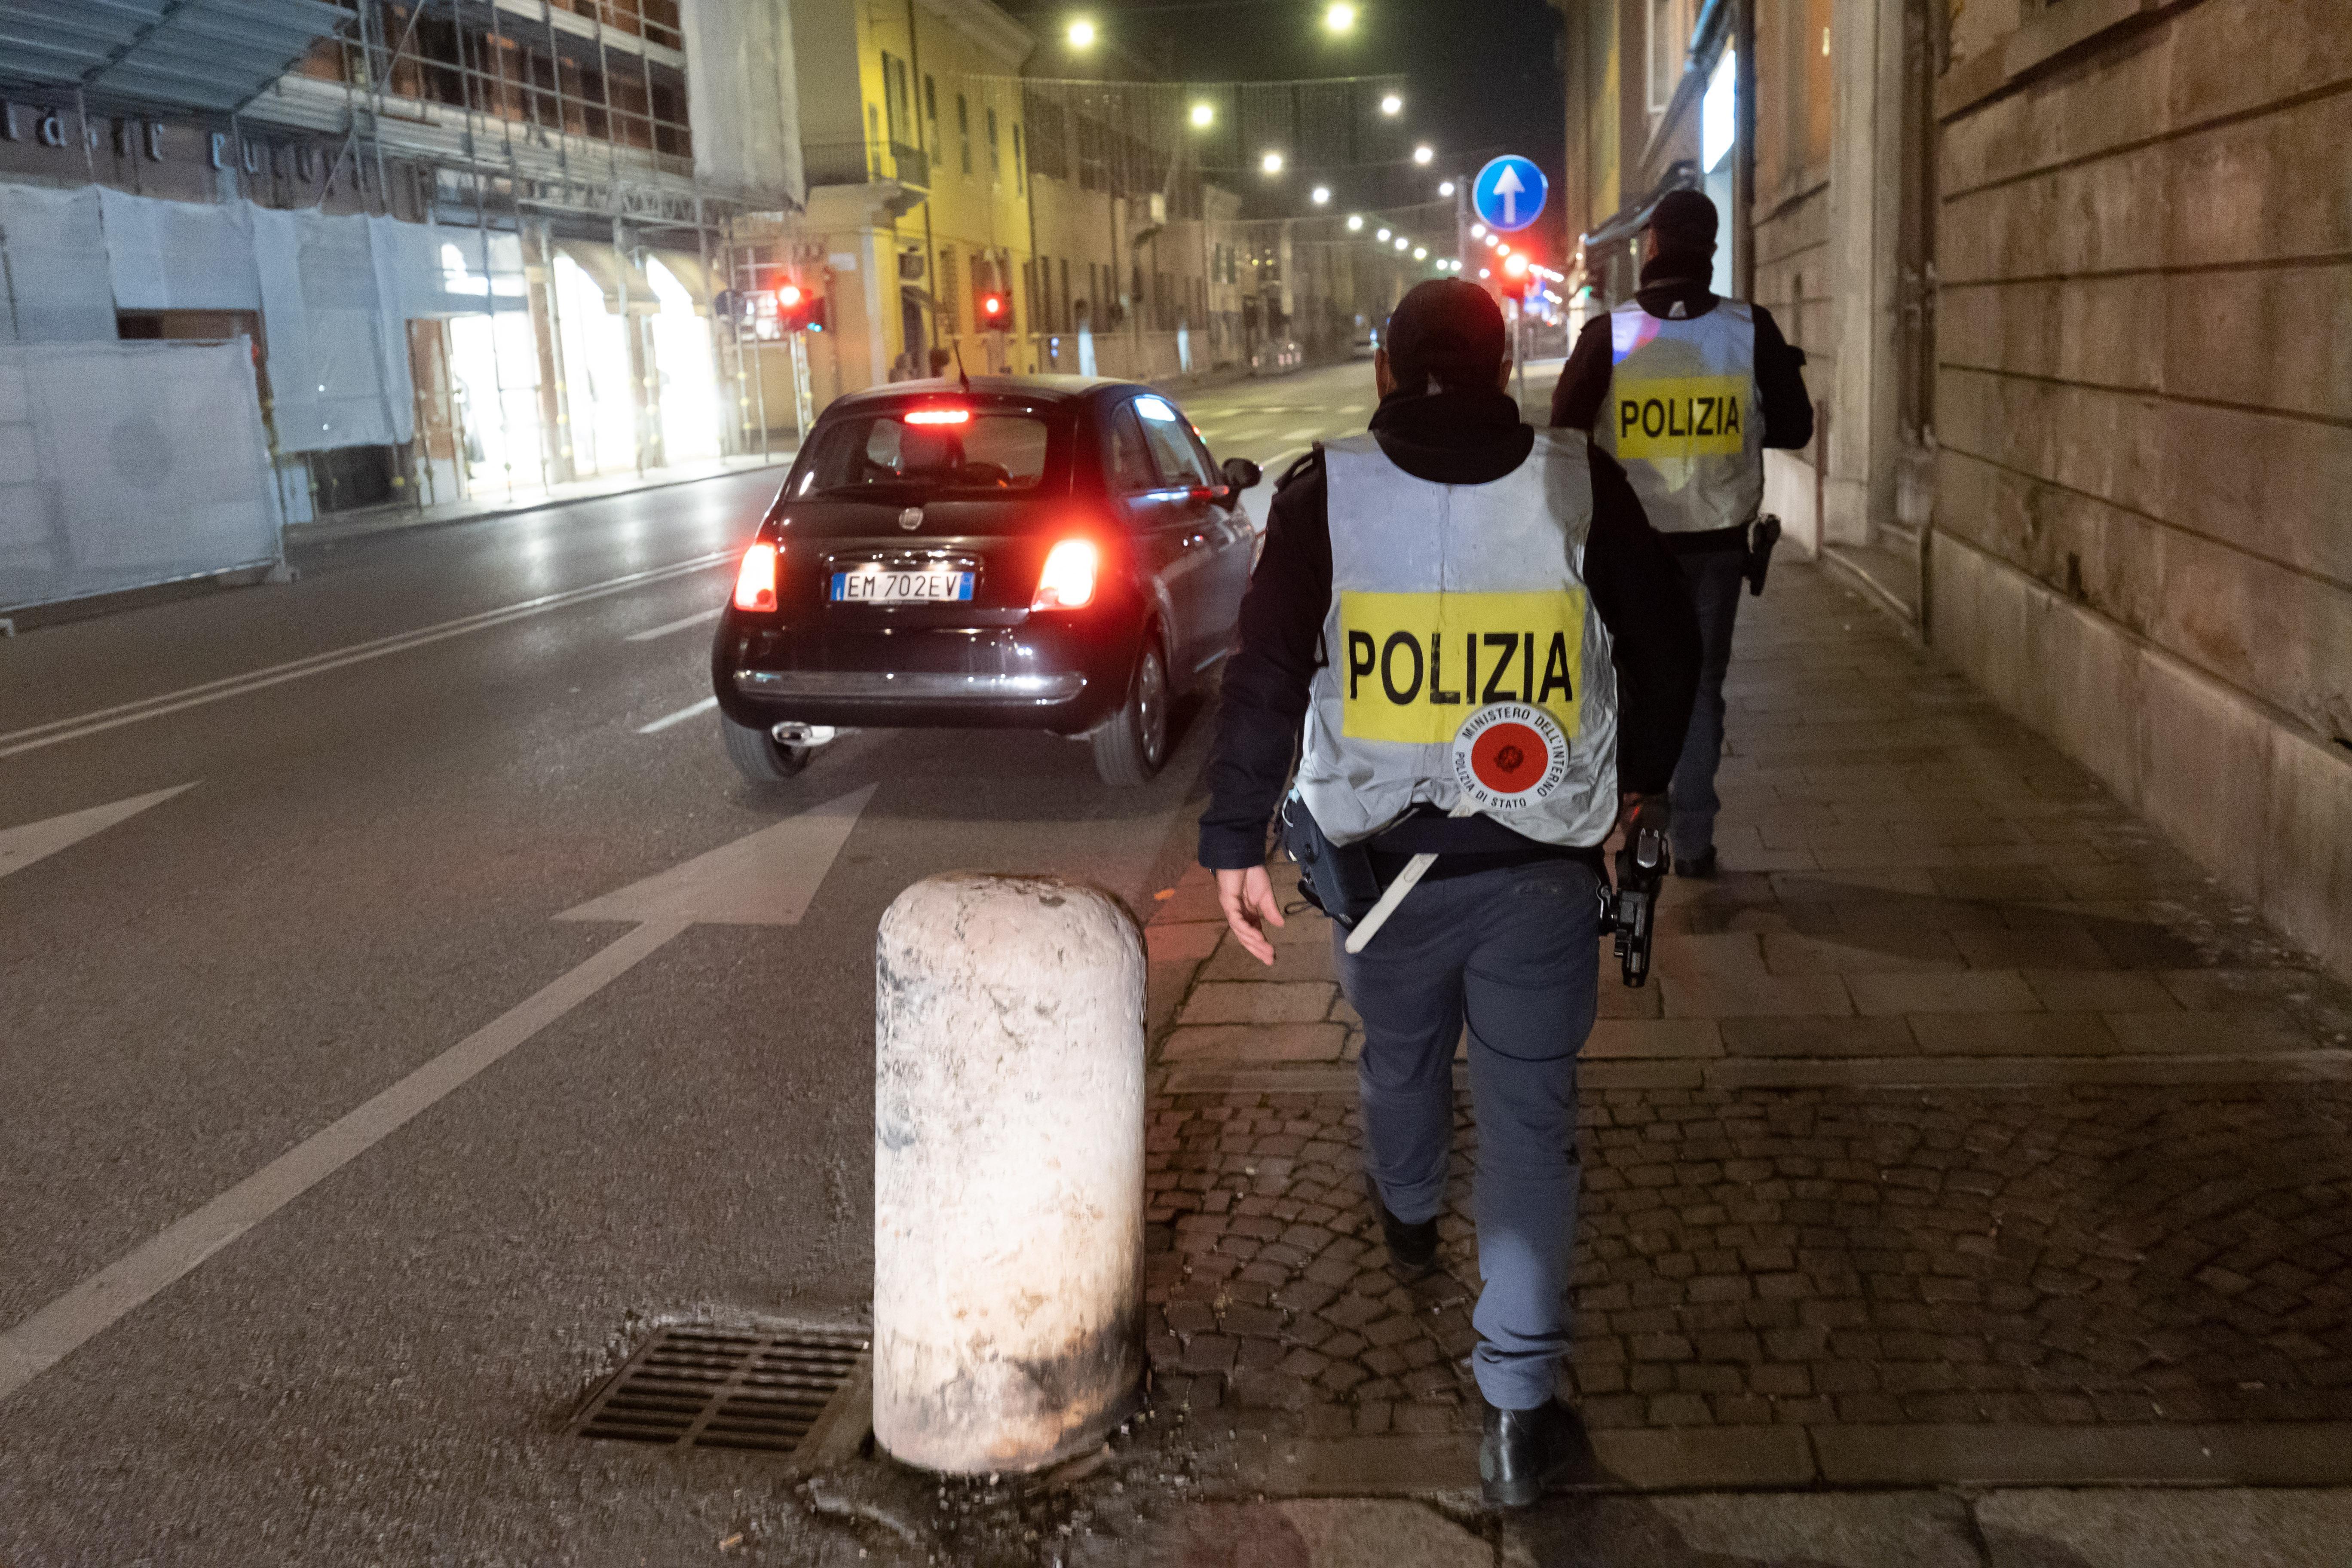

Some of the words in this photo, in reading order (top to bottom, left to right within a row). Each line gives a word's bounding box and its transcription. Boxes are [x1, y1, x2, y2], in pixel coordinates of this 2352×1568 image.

[1621, 396, 1740, 438] POLIZIA
[848, 576, 876, 597] EM
[885, 575, 957, 597] 702EV
[1348, 630, 1573, 705] POLIZIA
[1455, 751, 1475, 792] POLIZIA
[1475, 790, 1488, 802] DI
[1491, 797, 1527, 808] STATO
[1462, 706, 1530, 740] MINISTERO
[1534, 715, 1565, 797] DELL'INTERNO
